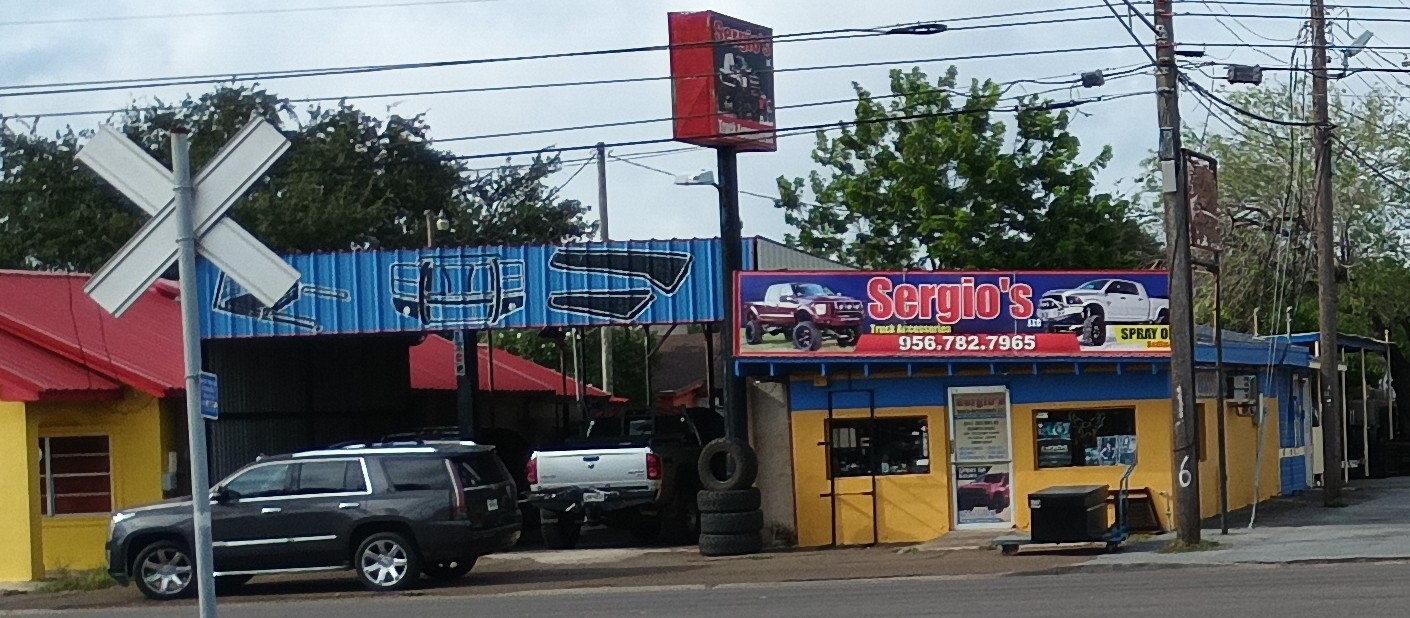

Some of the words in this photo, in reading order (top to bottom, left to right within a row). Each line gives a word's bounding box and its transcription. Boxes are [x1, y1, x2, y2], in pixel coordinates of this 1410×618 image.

[867, 276, 1034, 324] Sergio's
[1121, 327, 1158, 339] SPRAY
[898, 335, 1036, 350] 956.782.7965
